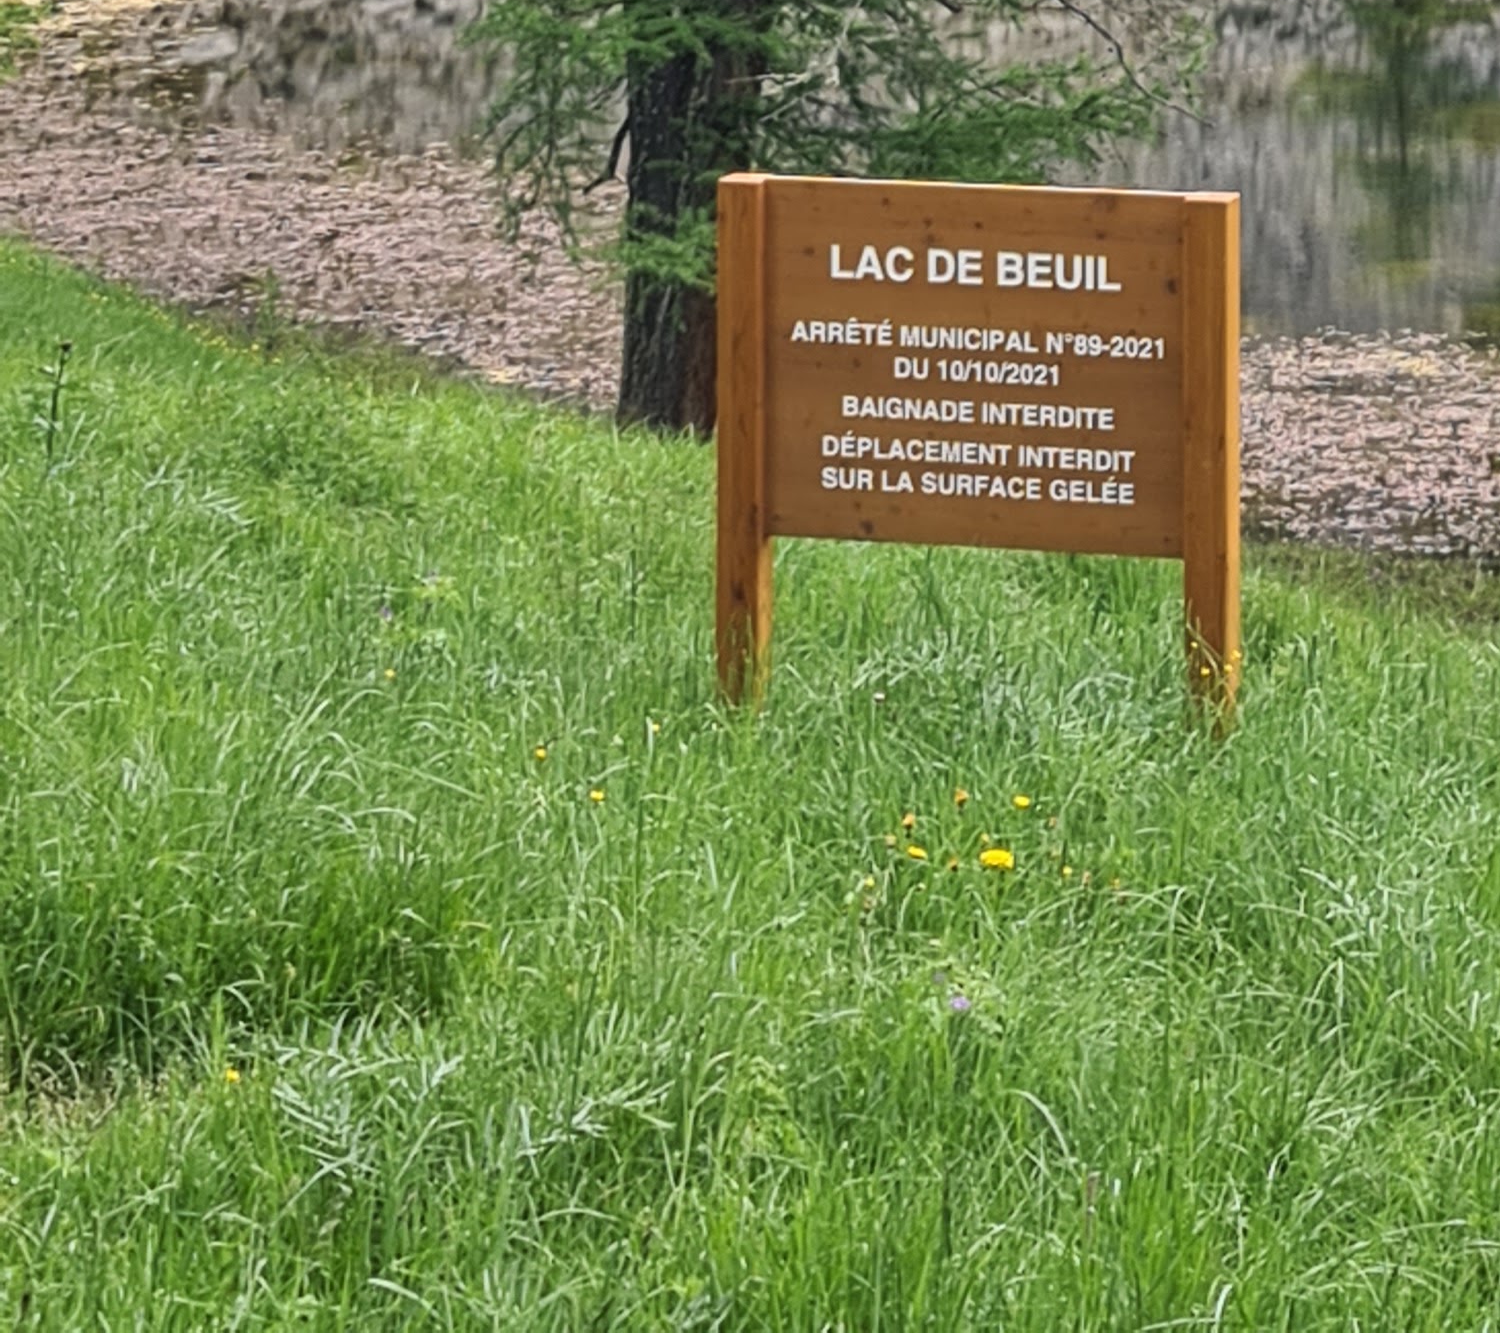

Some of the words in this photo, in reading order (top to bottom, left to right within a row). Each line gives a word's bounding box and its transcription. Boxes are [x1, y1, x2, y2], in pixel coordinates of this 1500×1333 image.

[830, 243, 914, 282] LAC
[926, 247, 984, 285] DE
[996, 250, 1122, 292] BEUIL
[790, 317, 893, 347] ARRÊTÉ
[899, 324, 1039, 354] MUNICIPAL
[1045, 331, 1165, 360] N°89-2021
[893, 356, 929, 381] DU
[936, 359, 1060, 387] 10/10/2021
[841, 395, 975, 424] BAIGNADE
[981, 400, 1115, 430] INTERDITE
[821, 430, 1013, 467] DÉPLACEMENT
[1018, 444, 1136, 473] INTERDIT
[821, 466, 874, 491] SUR
[880, 469, 914, 494] LA
[920, 471, 1042, 500] SURFACE
[1048, 476, 1135, 505] GELÉE
